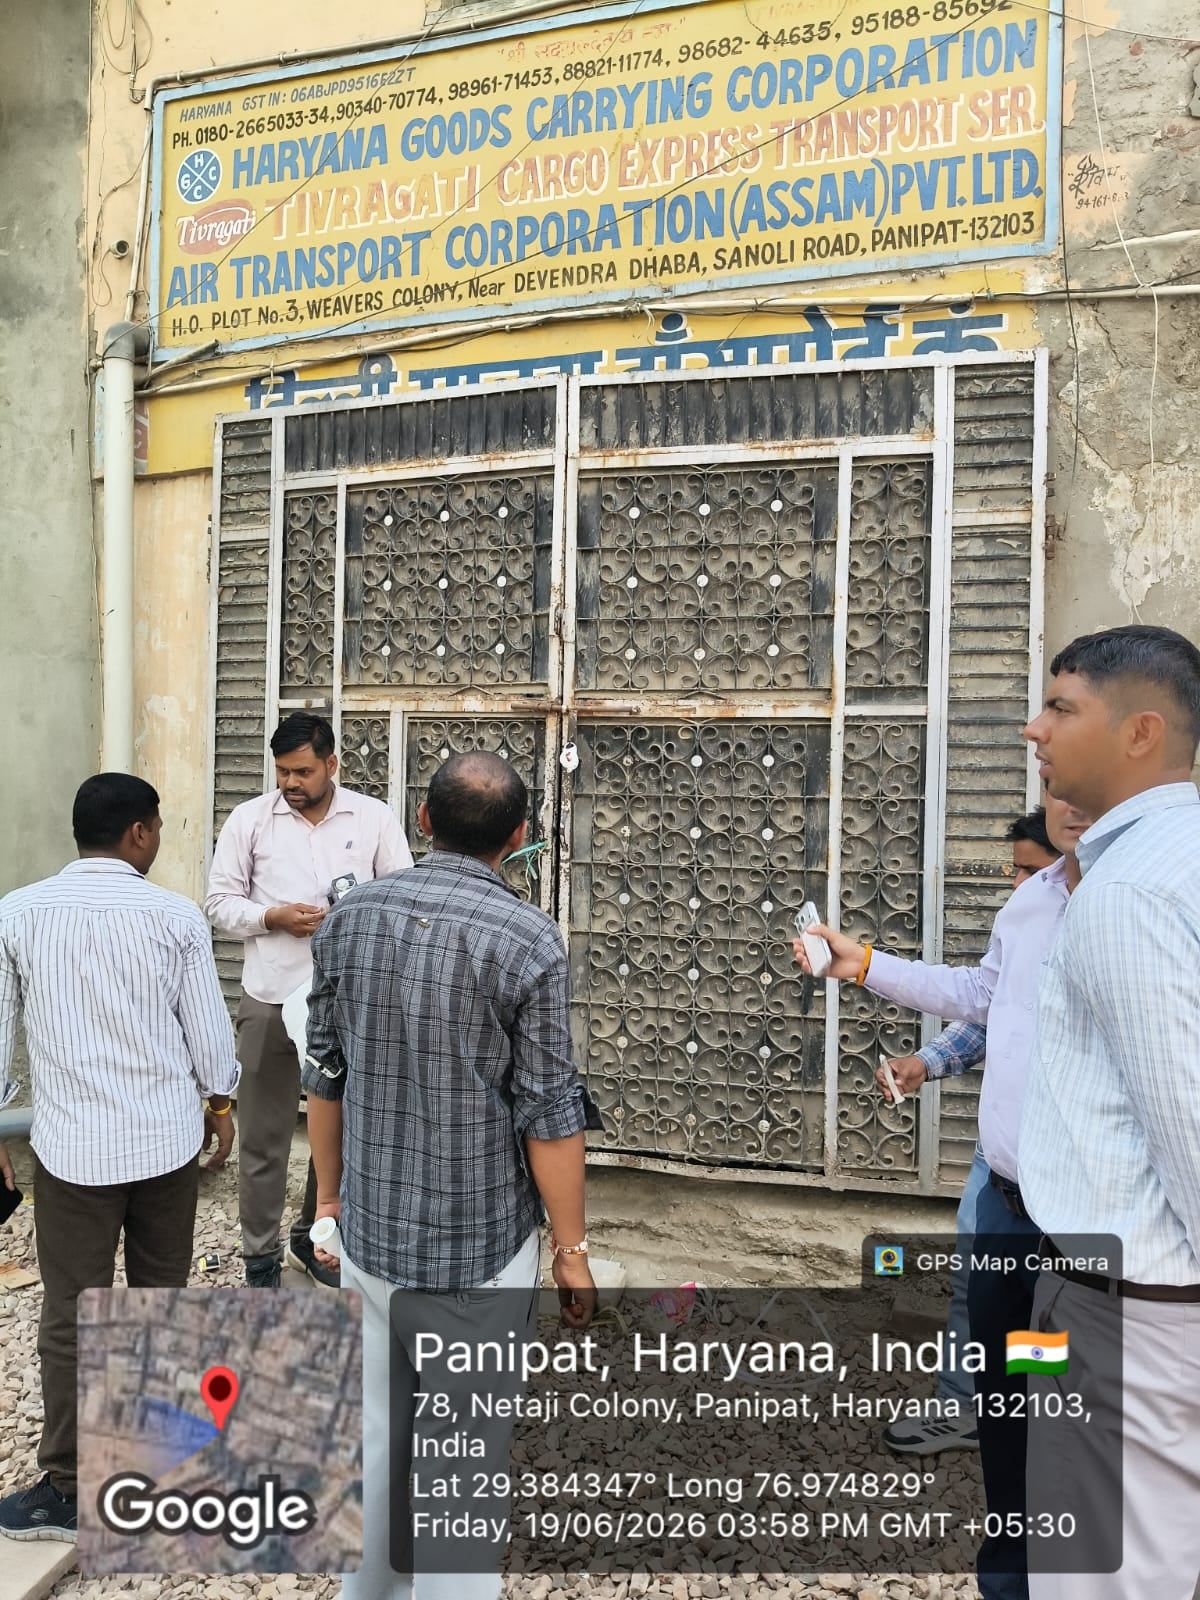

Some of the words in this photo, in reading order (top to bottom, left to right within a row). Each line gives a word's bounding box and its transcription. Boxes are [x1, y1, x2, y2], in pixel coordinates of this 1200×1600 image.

[172, 130, 193, 149] PH.
[179, 100, 232, 123] HARYANA
[232, 124, 388, 189] HARYANA
[400, 104, 513, 162] GOODS
[526, 71, 713, 143] CARRYING
[726, 18, 1038, 113] CORPORATION
[264, 164, 480, 241] TIVRAGATI
[497, 146, 609, 206] CARGO
[617, 124, 766, 191] EXPRESS
[770, 94, 966, 171] TRANSPORT
[967, 83, 1046, 143] SER.
[176, 208, 257, 246] Tivragati
[167, 261, 219, 308] AIR
[230, 229, 432, 299] TRANSPORT
[211, 307, 252, 331] PLOT
[307, 290, 383, 320] WEAVERS
[392, 280, 463, 308] COLONY,
[468, 275, 505, 298] Near
[514, 260, 618, 293] DEVENDRA
[628, 250, 707, 280] DHABA,
[712, 239, 795, 271] SANOLI
[803, 233, 867, 260] ROAD,
[871, 211, 1036, 252] PANIPAT-132103
